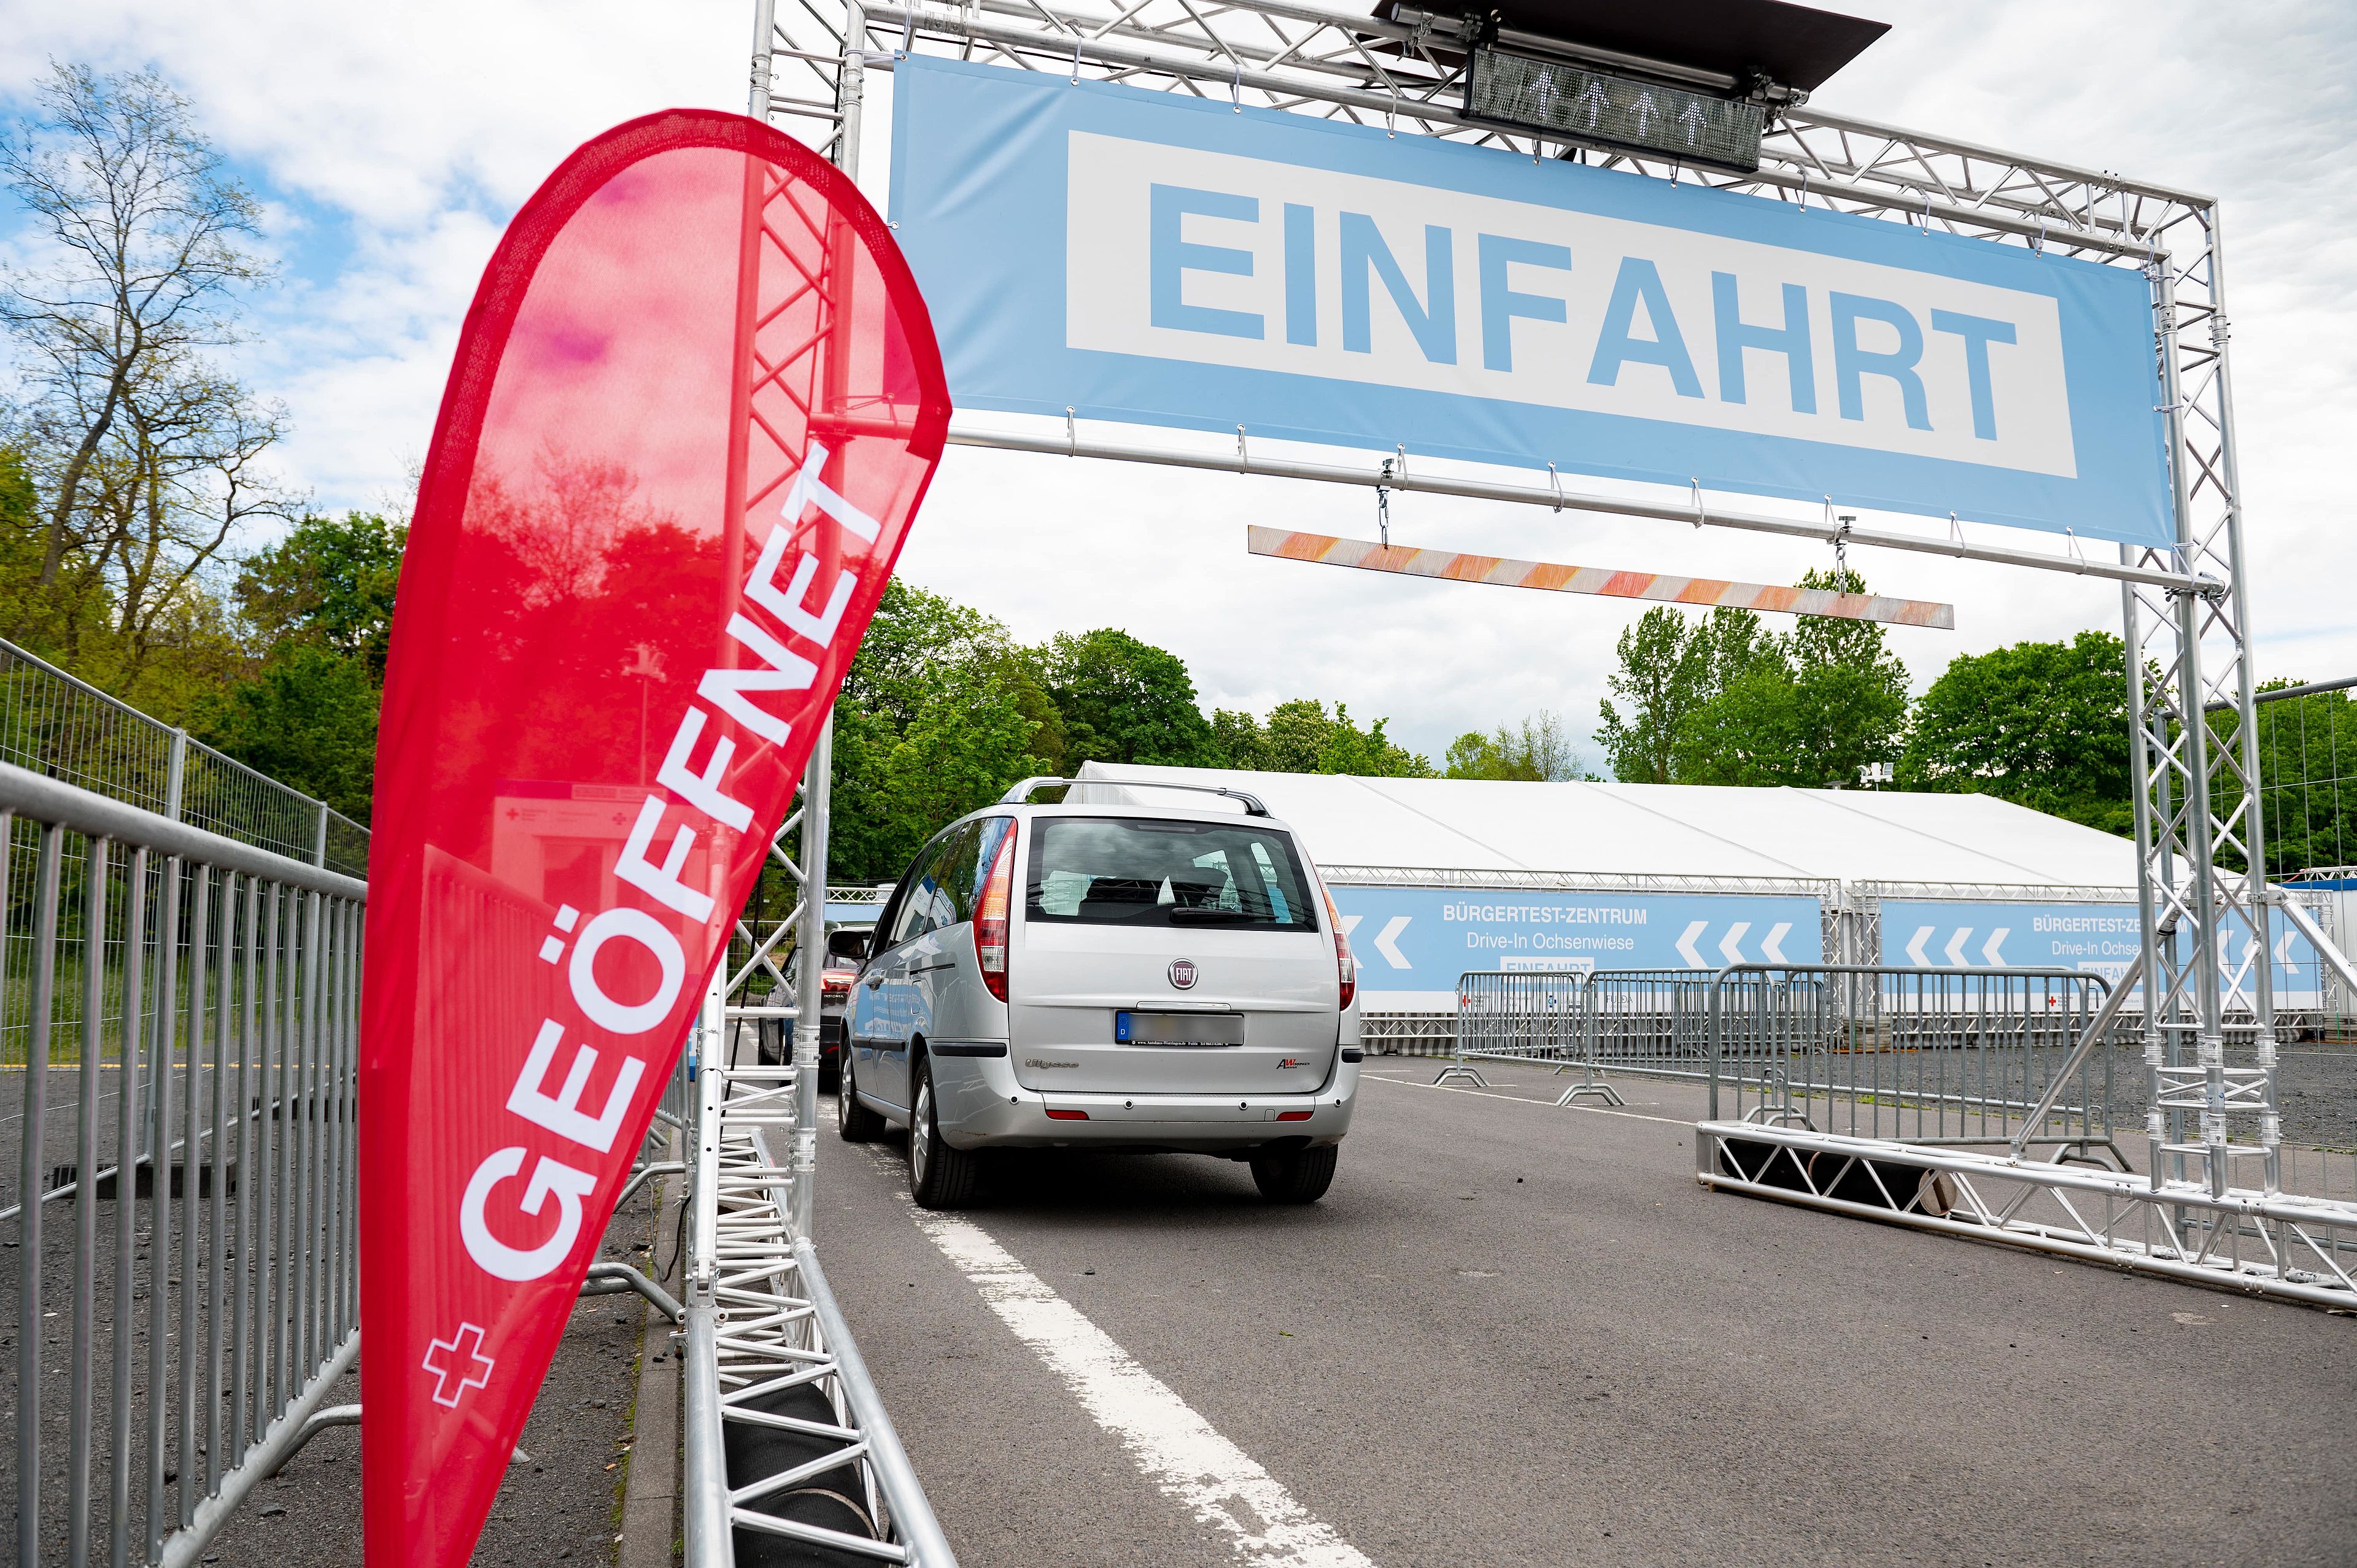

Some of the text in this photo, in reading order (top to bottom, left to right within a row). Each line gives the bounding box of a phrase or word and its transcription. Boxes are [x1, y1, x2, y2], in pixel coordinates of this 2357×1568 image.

[1150, 182, 2017, 442] EINFAHRT
[459, 442, 883, 1282] GEÖFFNET
[1443, 902, 1647, 925] BÜRGERTEST-ZENTRUM
[1466, 932, 1635, 950] Drive-In Ochsenwiese
[2051, 940, 2098, 956] Drive-In
[1175, 967, 1192, 981] FIAT
[1025, 1059, 1079, 1070] Ulysse
